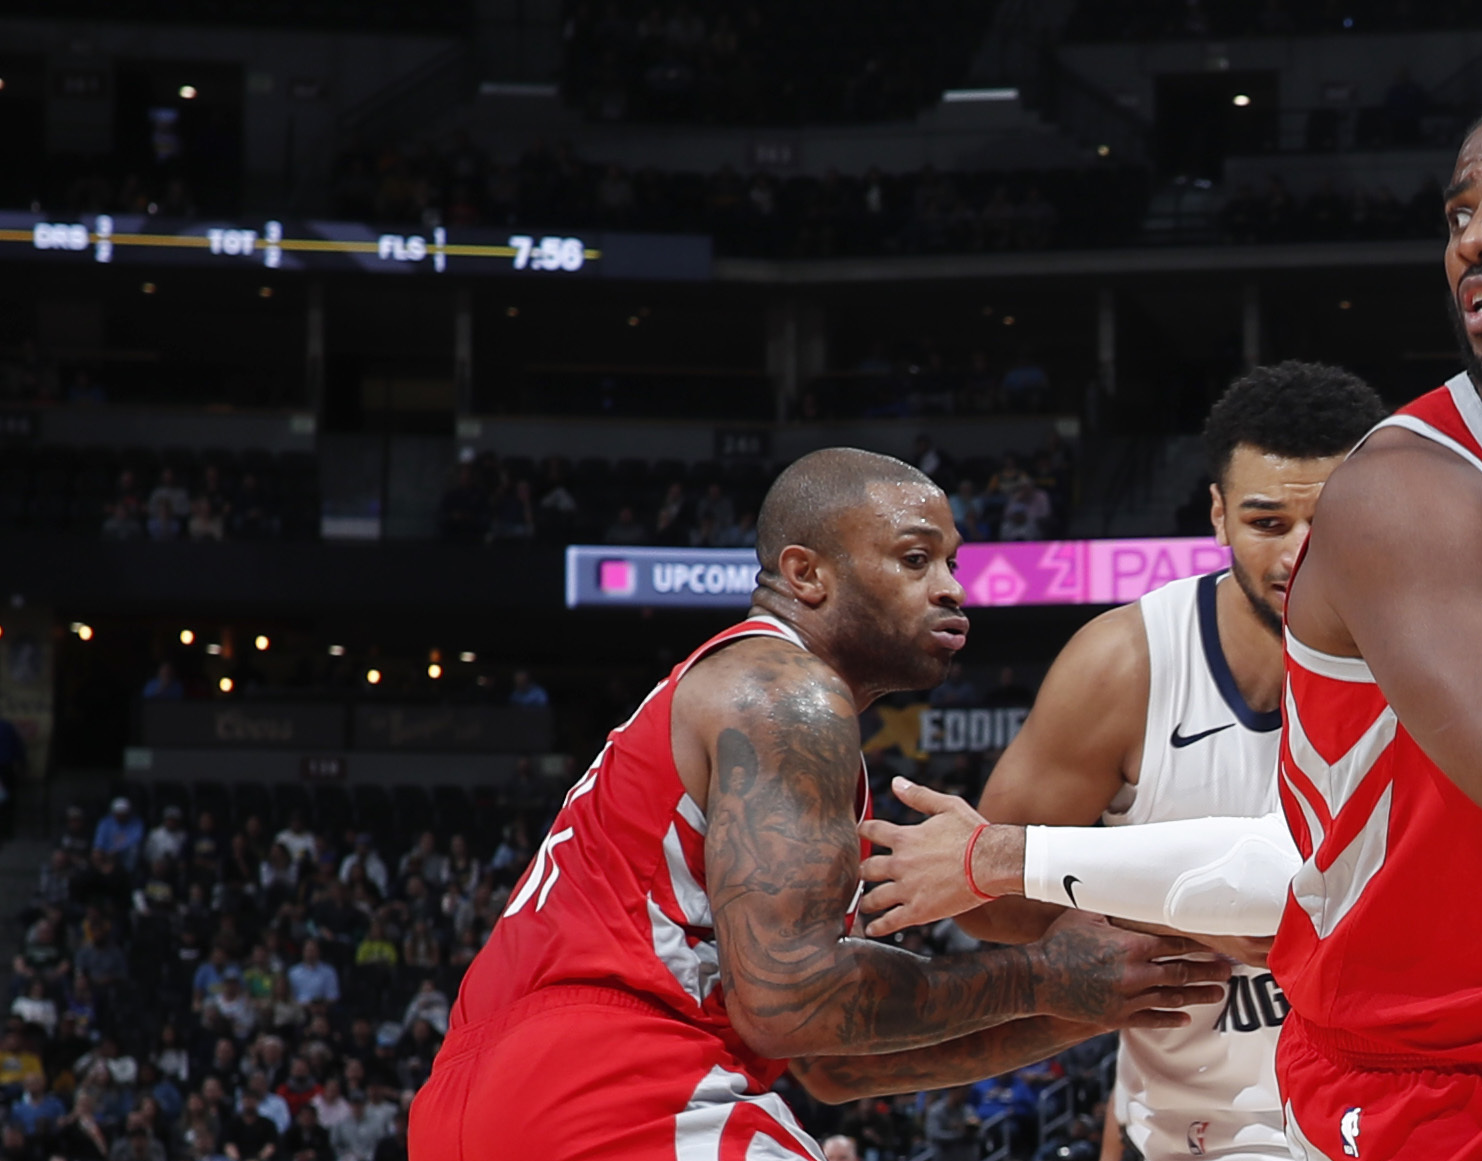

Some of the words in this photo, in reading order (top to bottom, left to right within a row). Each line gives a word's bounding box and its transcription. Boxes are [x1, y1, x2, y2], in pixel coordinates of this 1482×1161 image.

[33, 222, 89, 250] DRB
[207, 228, 257, 255] TOT
[378, 235, 427, 261] FLS
